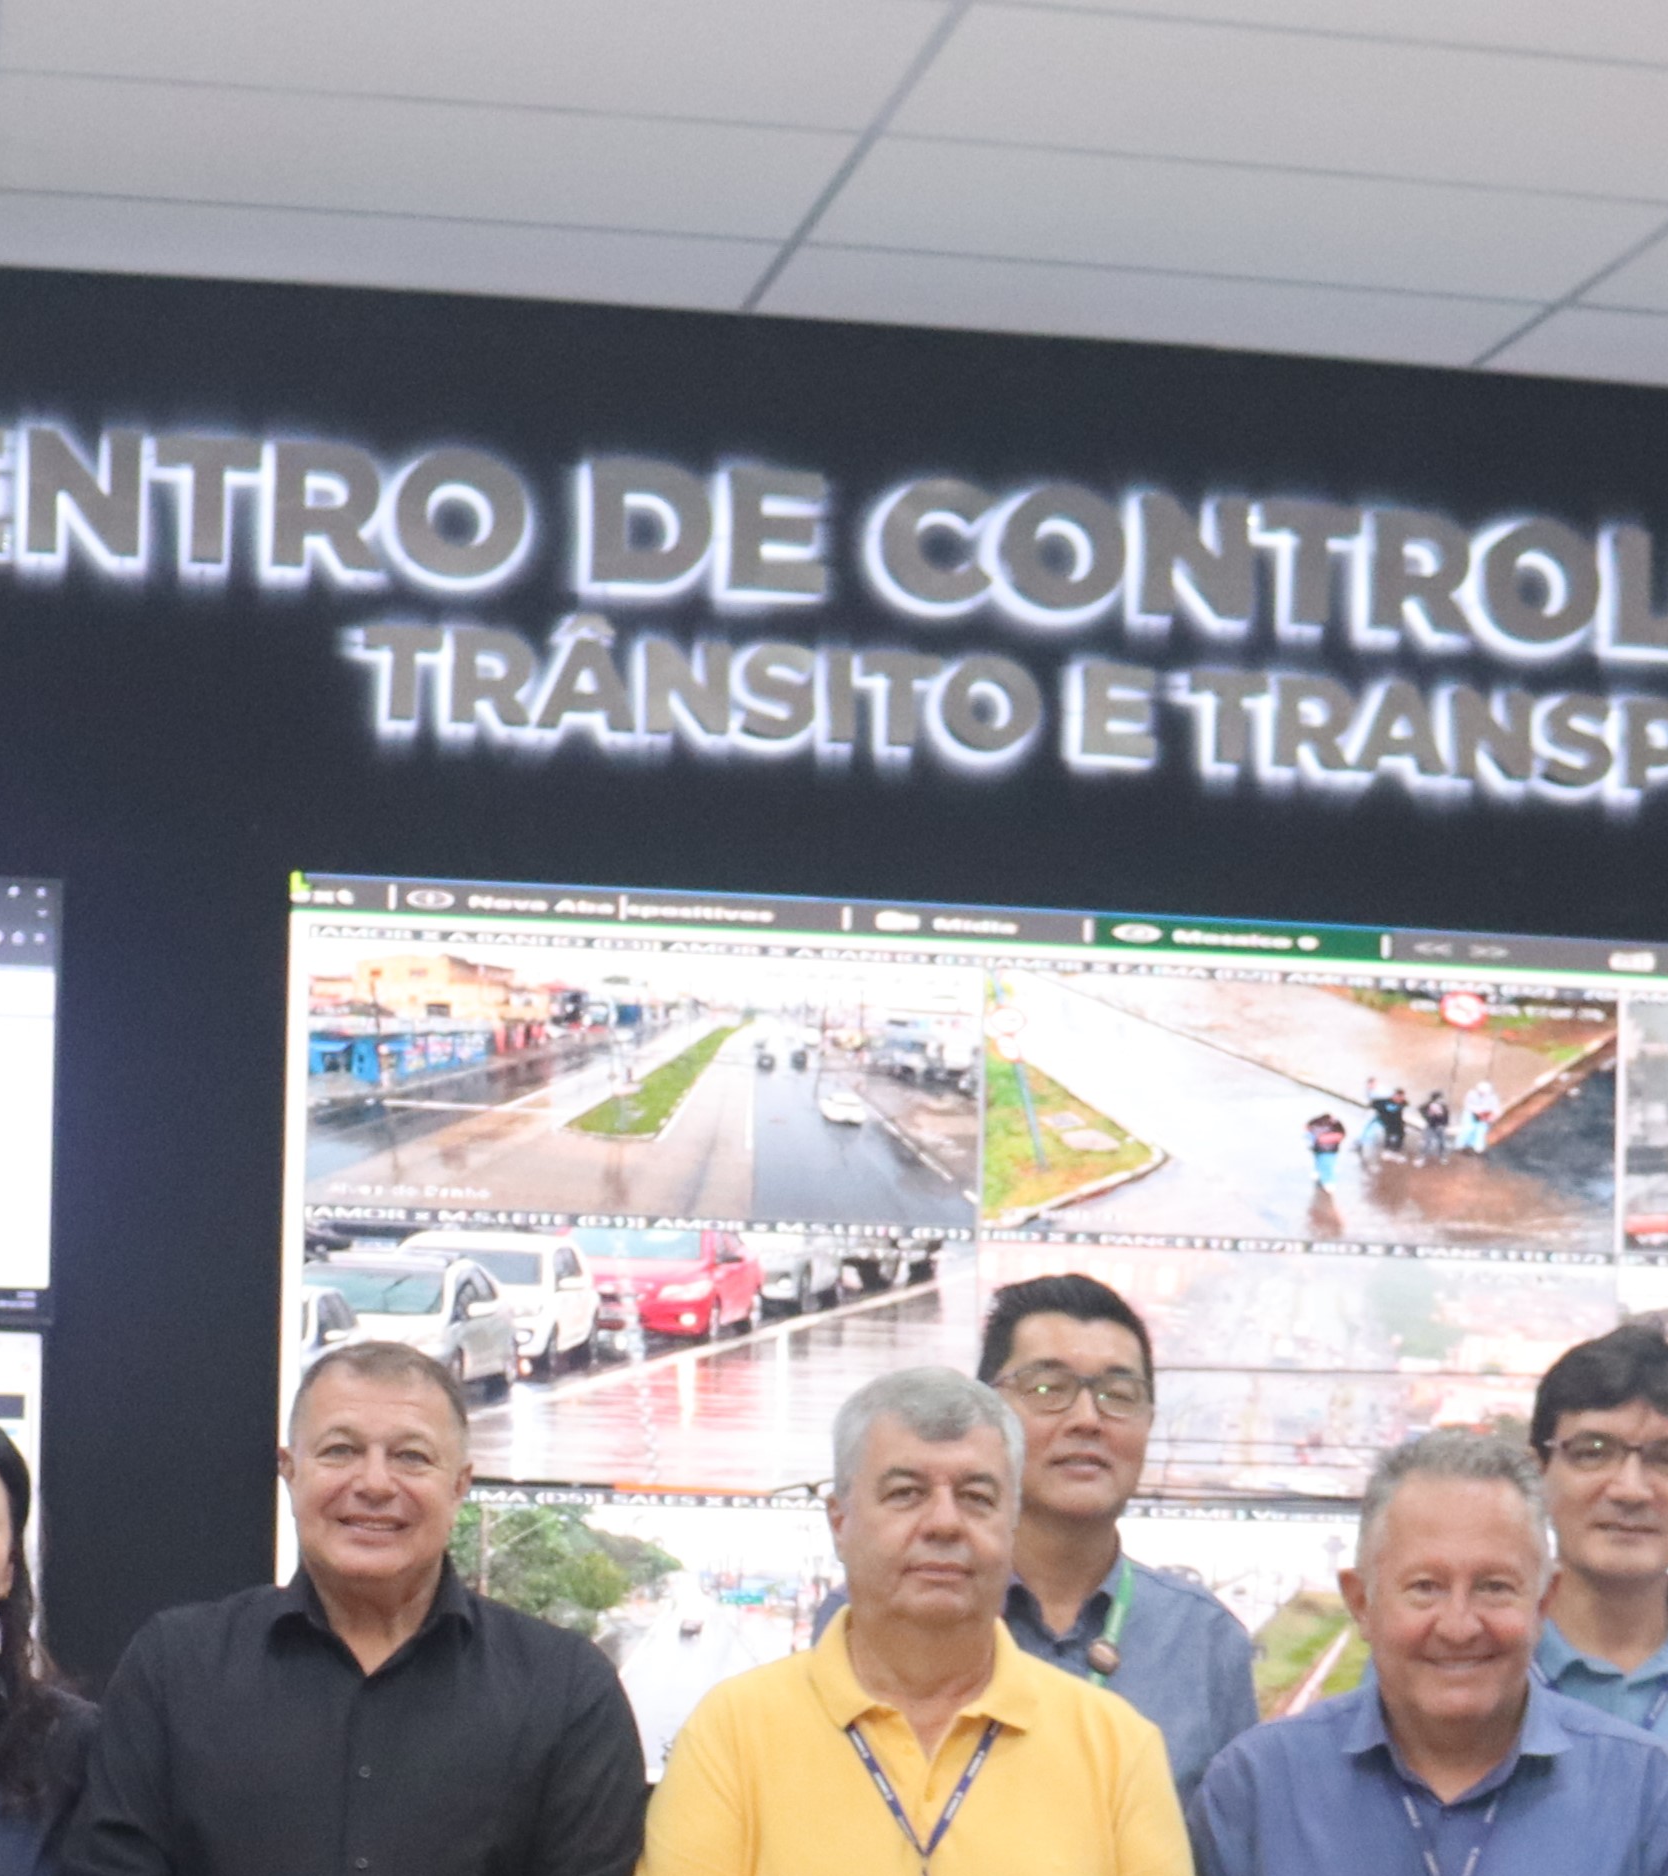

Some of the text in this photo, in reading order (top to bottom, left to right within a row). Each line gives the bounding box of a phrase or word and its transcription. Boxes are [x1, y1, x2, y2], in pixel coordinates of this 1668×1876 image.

[579, 455, 828, 601] DE
[356, 614, 1042, 764] TRÂNSITO
[1066, 663, 1156, 770] E
